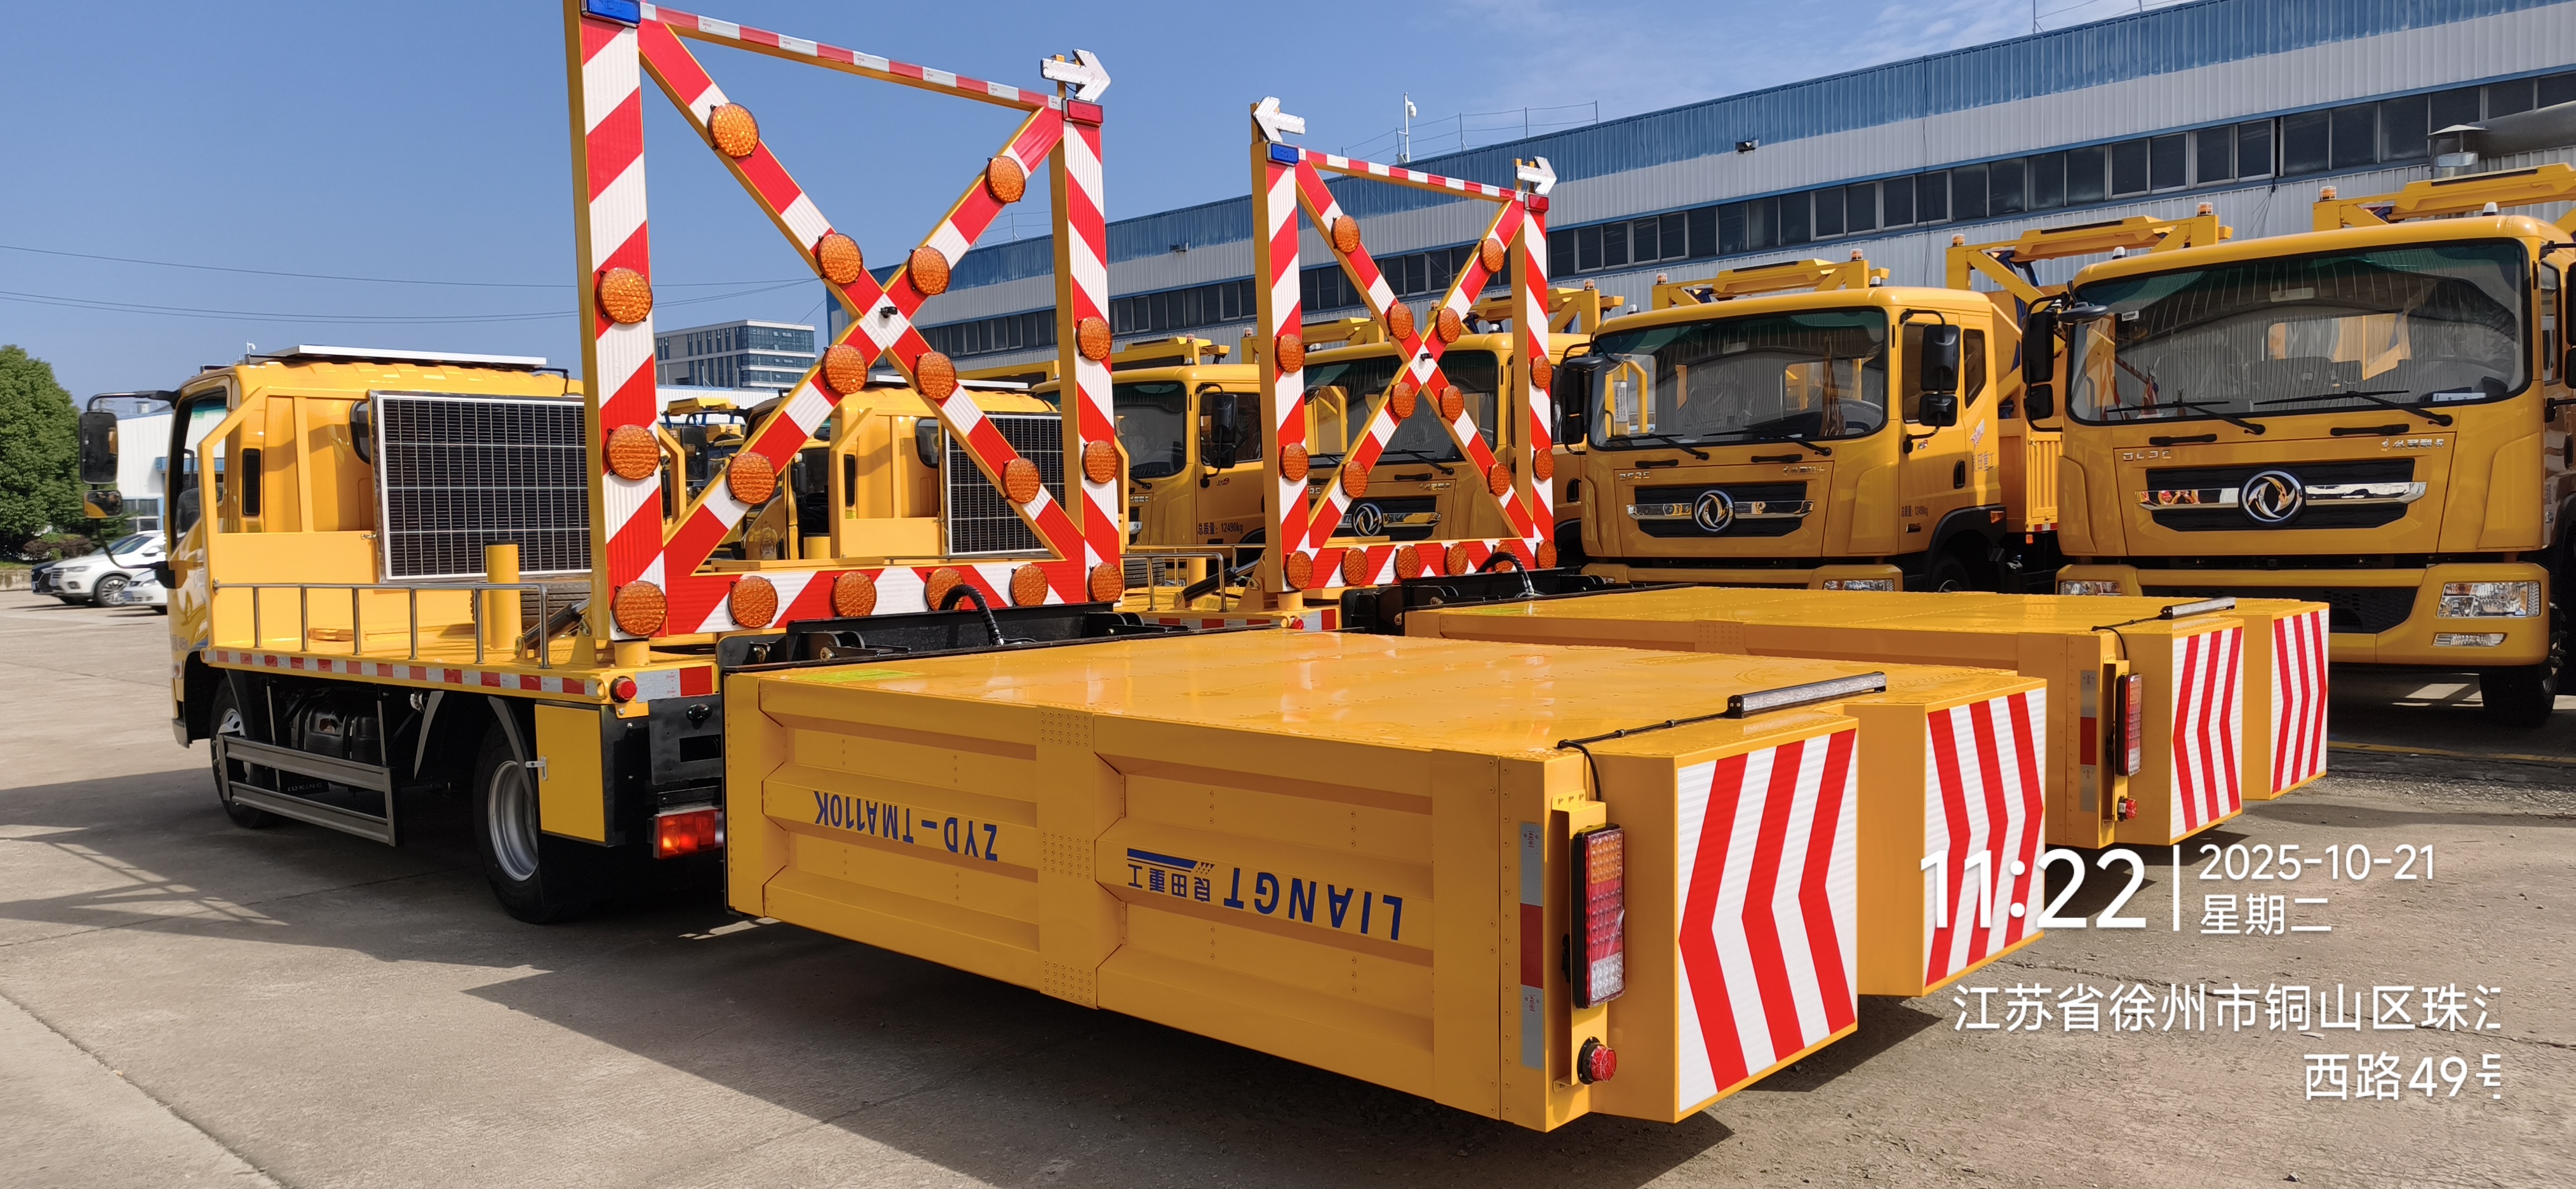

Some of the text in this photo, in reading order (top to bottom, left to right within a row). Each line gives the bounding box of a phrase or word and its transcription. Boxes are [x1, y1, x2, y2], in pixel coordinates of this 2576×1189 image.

[1127, 863, 1404, 941] LIANGT 良田重工
